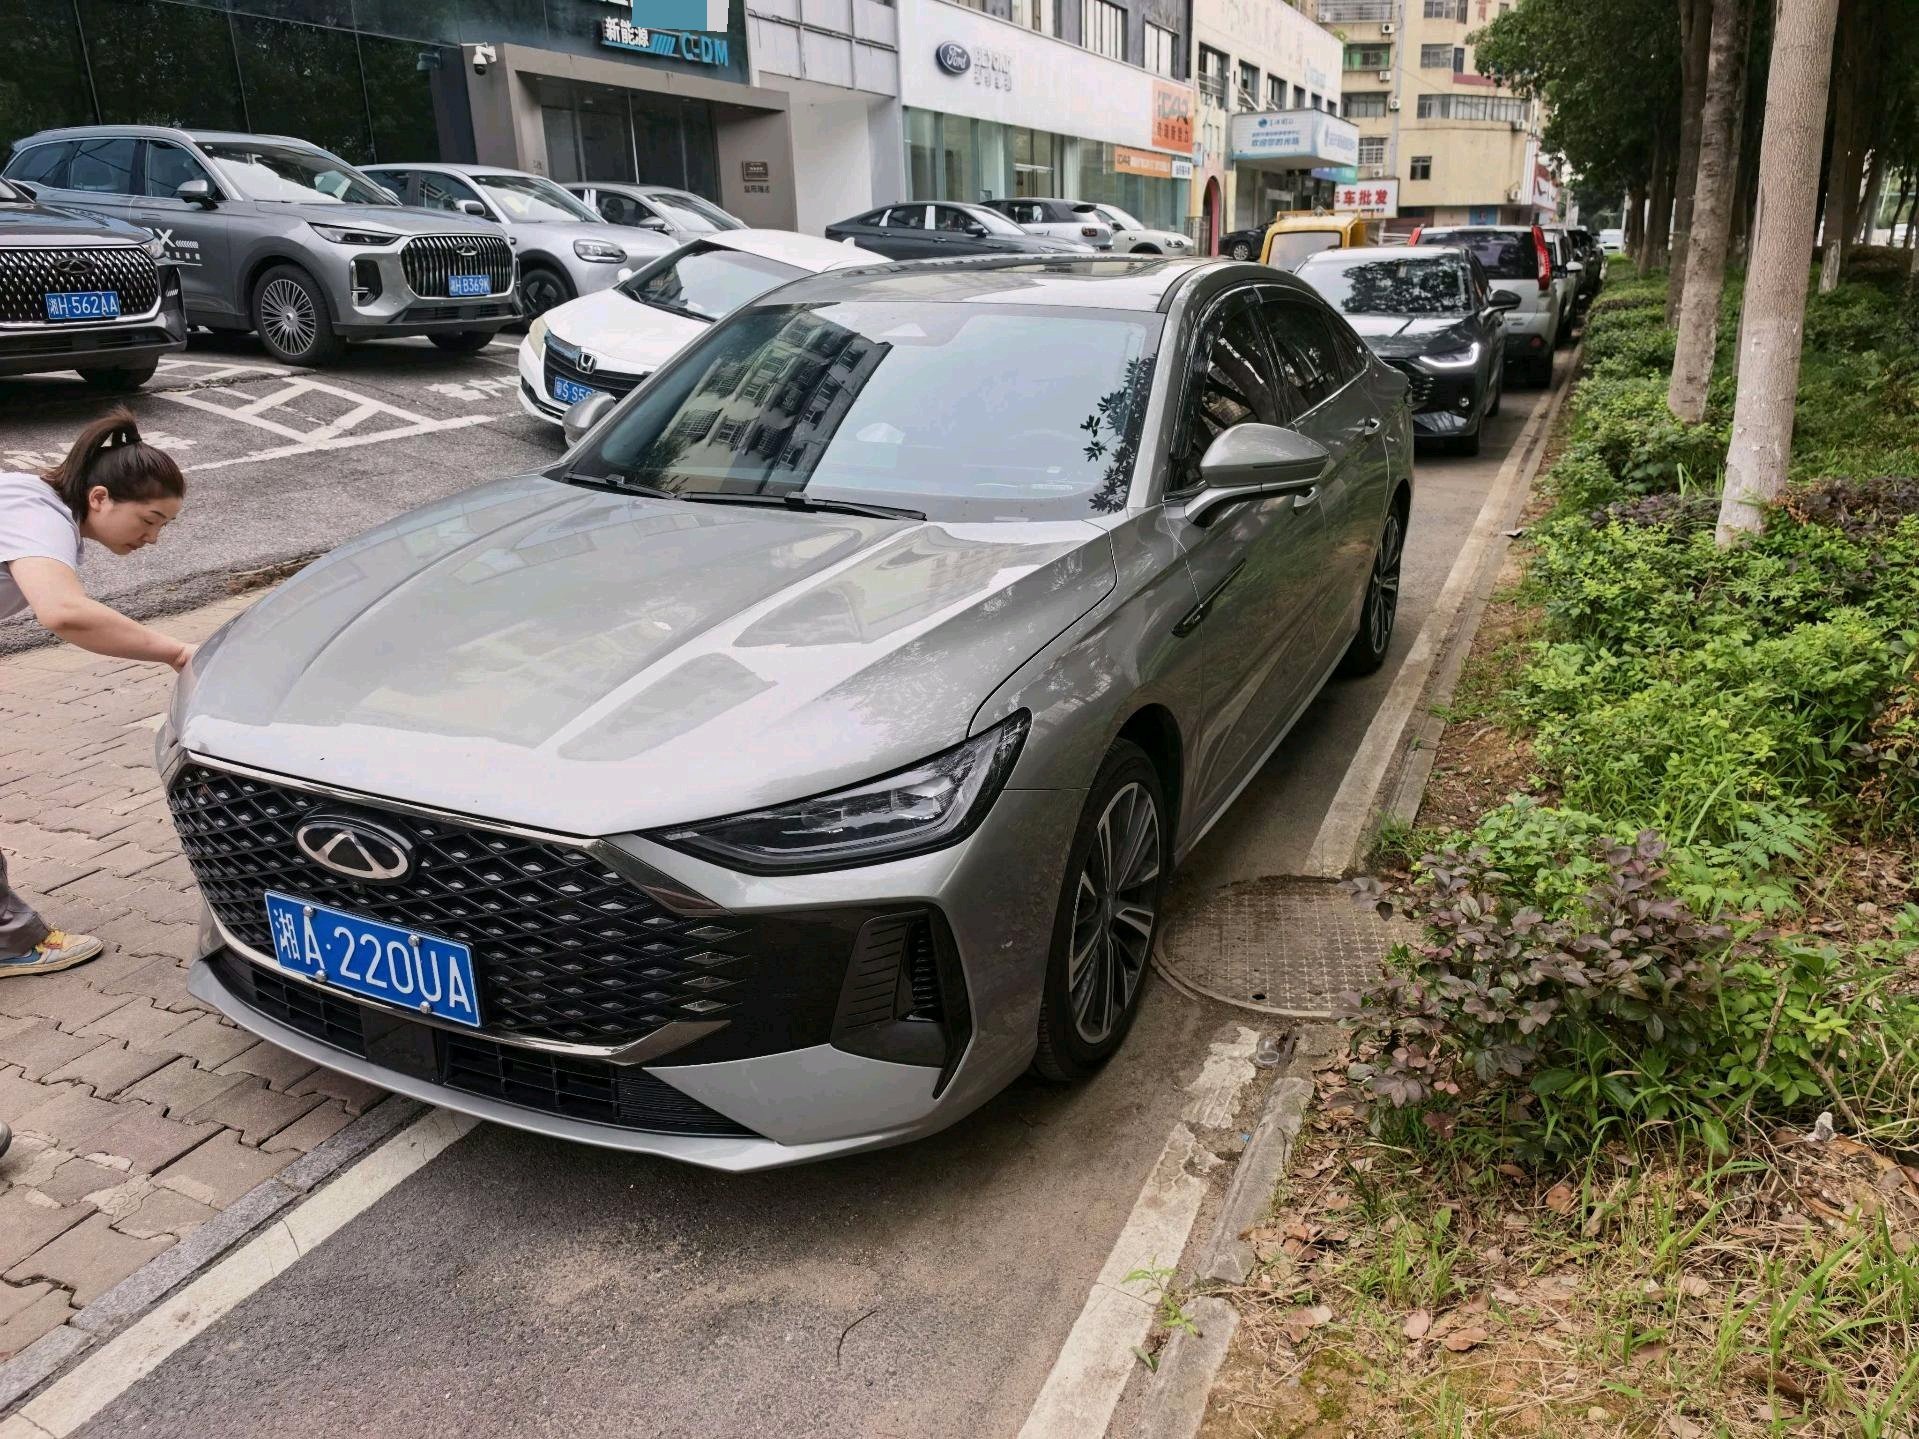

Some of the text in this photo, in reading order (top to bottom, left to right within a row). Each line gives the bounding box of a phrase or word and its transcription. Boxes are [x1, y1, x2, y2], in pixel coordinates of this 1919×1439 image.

[605, 16, 649, 48] 新能源
[947, 45, 967, 69] Ford
